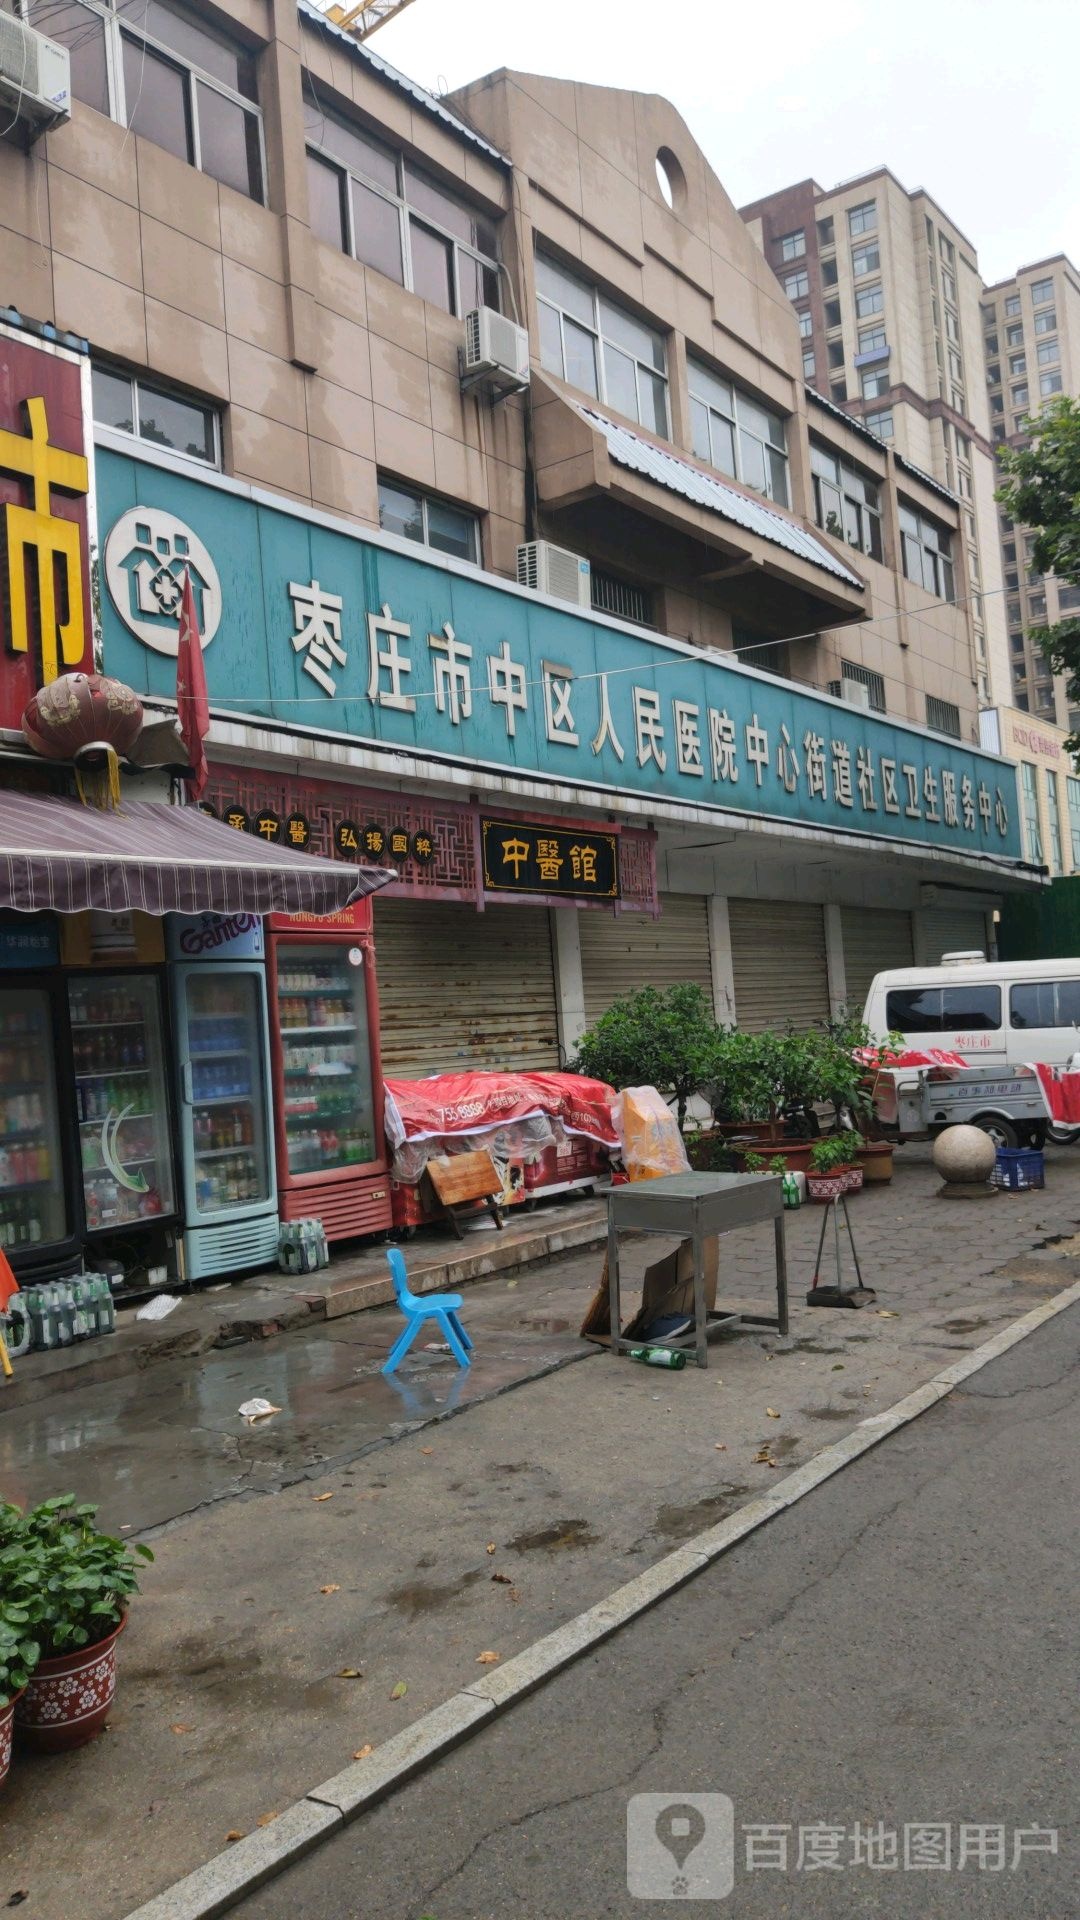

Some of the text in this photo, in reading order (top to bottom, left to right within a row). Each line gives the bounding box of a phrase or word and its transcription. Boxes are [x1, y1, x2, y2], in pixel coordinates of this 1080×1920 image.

[0, 396, 88, 688] 市
[289, 580, 1008, 836] 枣庄市中区人民医院中心街道社区卫生服务中心
[341, 828, 433, 857] 弘揚國粹
[501, 837, 597, 882] 中醫館
[326, 912, 355, 924] SPRING
[955, 1034, 992, 1048] 枣庄市
